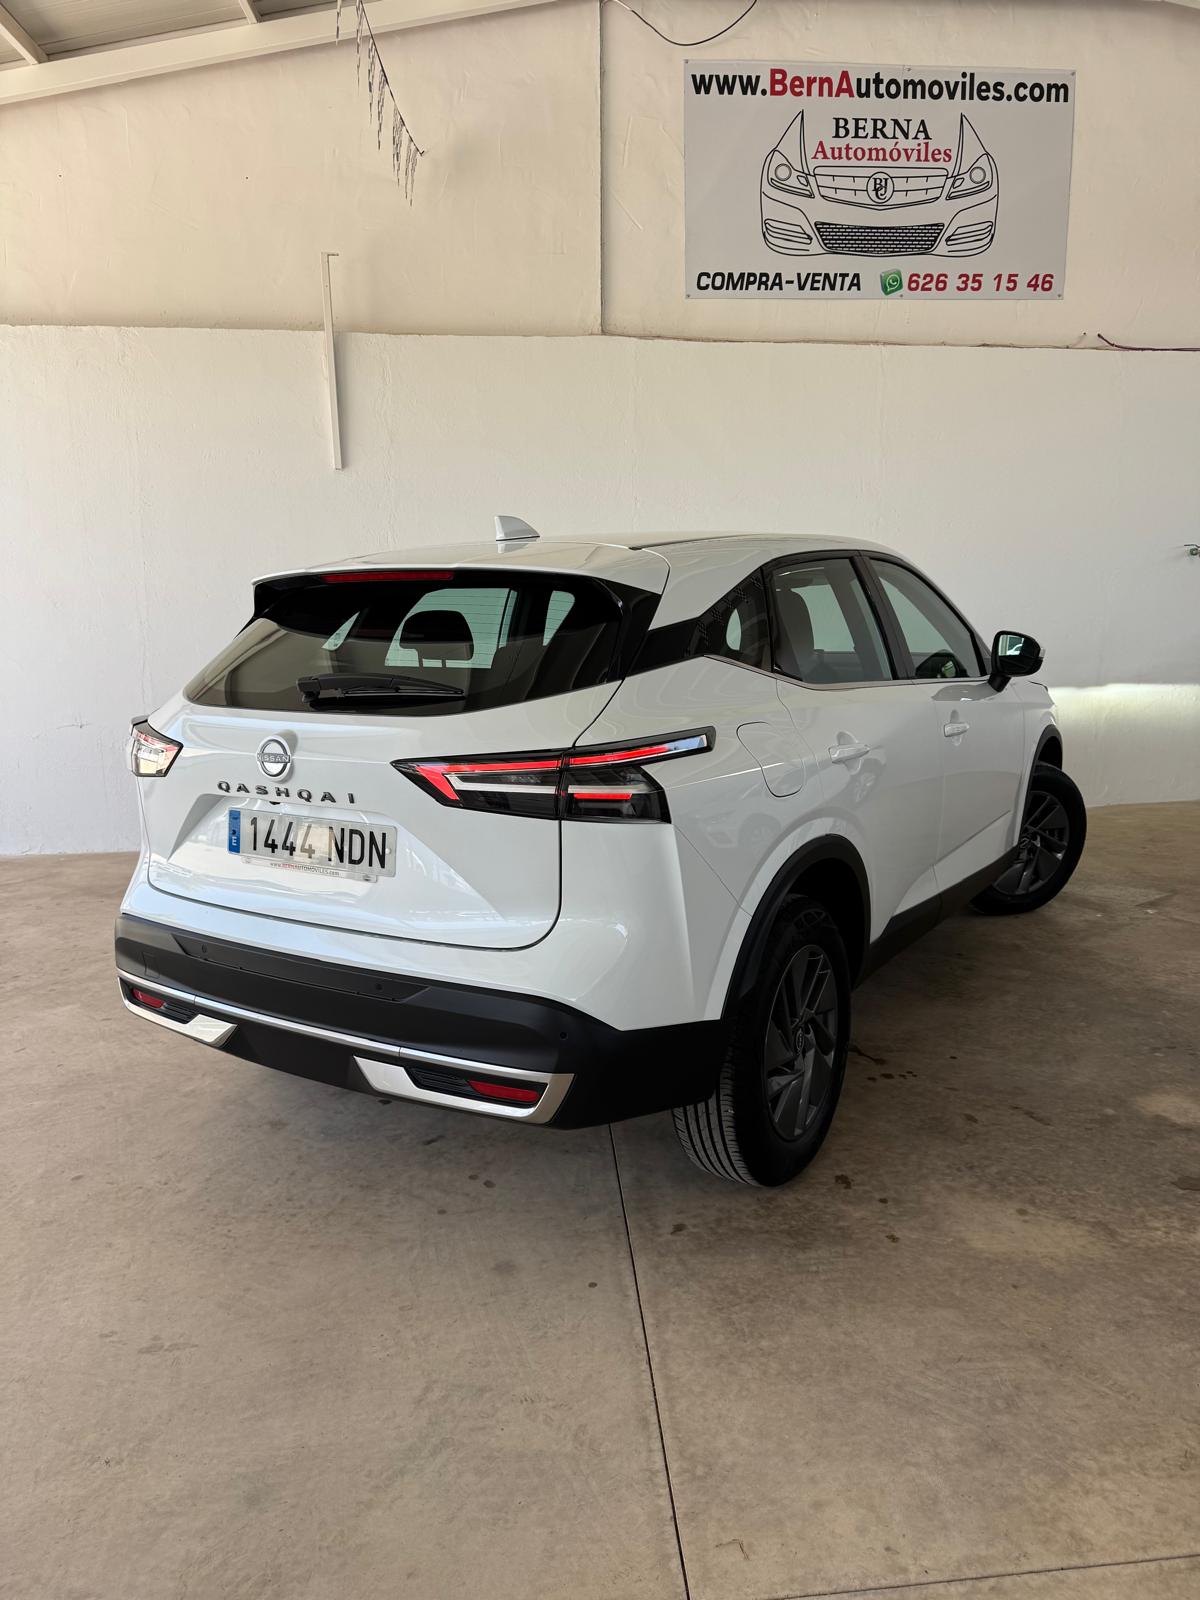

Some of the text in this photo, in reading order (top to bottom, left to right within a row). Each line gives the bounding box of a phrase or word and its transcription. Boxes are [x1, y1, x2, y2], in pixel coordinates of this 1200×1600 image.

[691, 68, 1069, 103] www.BernAutomoviles.com
[832, 117, 932, 140] BERNA
[811, 140, 952, 163] Automóviles
[696, 271, 862, 291] COMPRA-VENTA
[907, 273, 1054, 292] 626 35 15 46
[217, 780, 356, 804] QASHQAI
[250, 817, 386, 869] 1444 NDN
